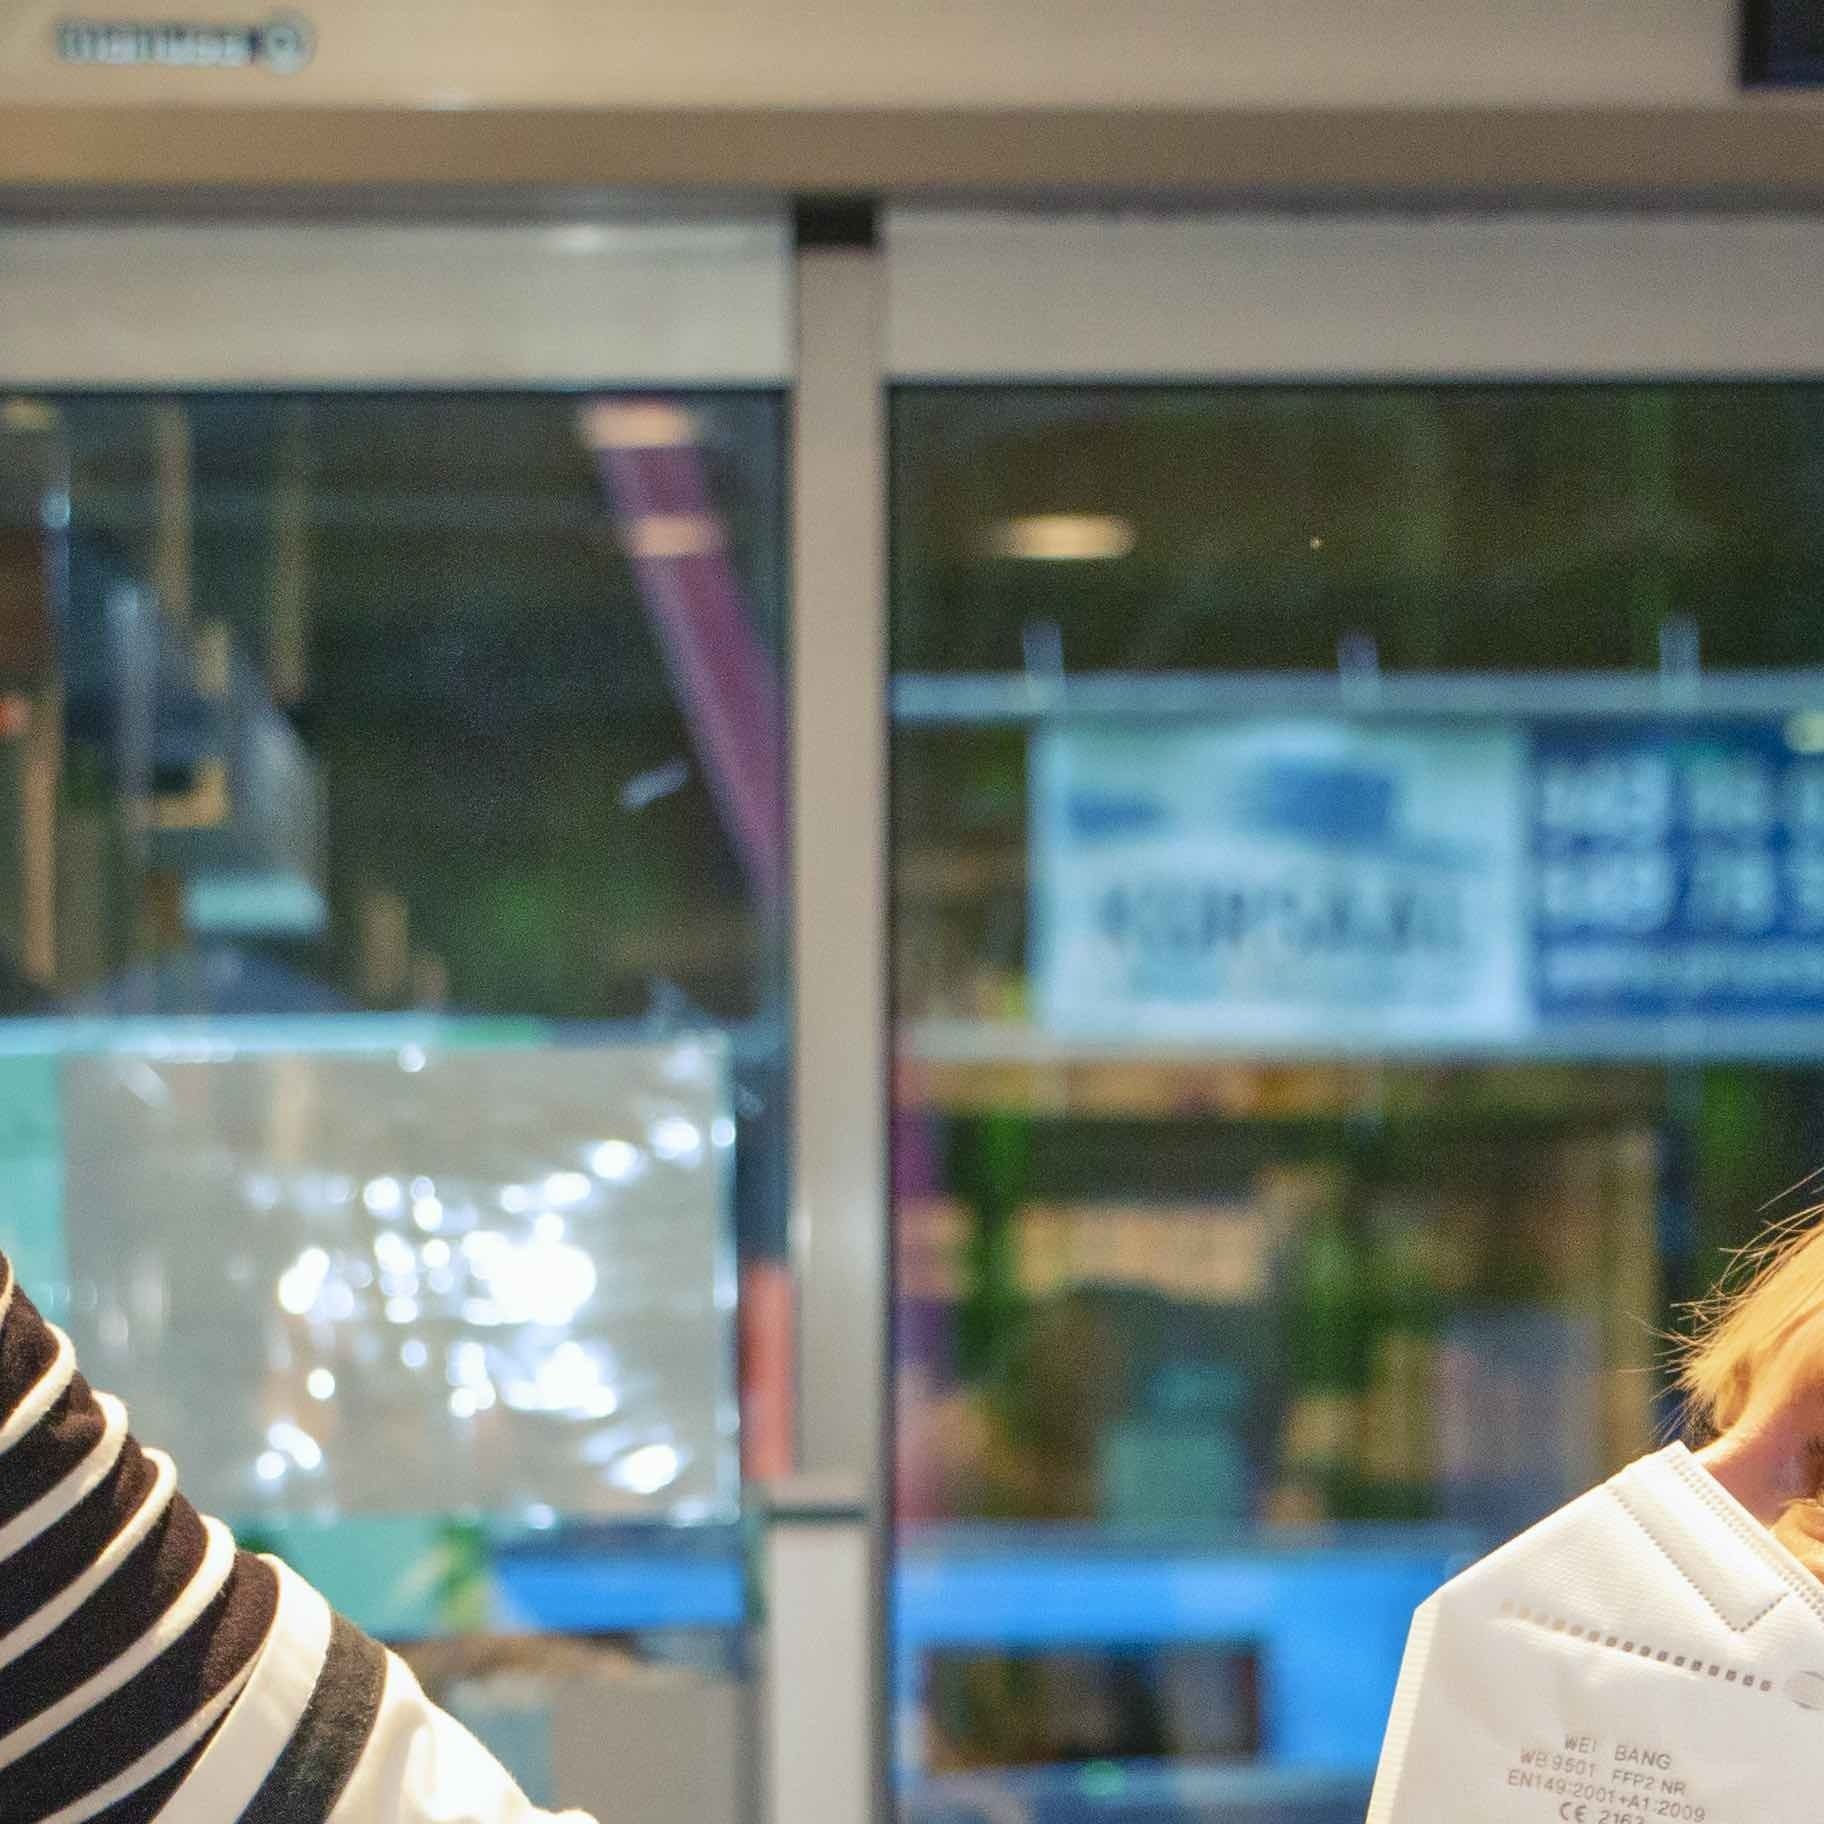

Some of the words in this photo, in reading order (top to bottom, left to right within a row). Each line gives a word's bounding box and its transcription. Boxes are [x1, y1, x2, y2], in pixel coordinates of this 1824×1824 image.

[1564, 1734, 1598, 1753] WEI
[1614, 1744, 1673, 1771] BANG
[1612, 1769, 1656, 1791] FFP2
[1660, 1779, 1688, 1797] NR
